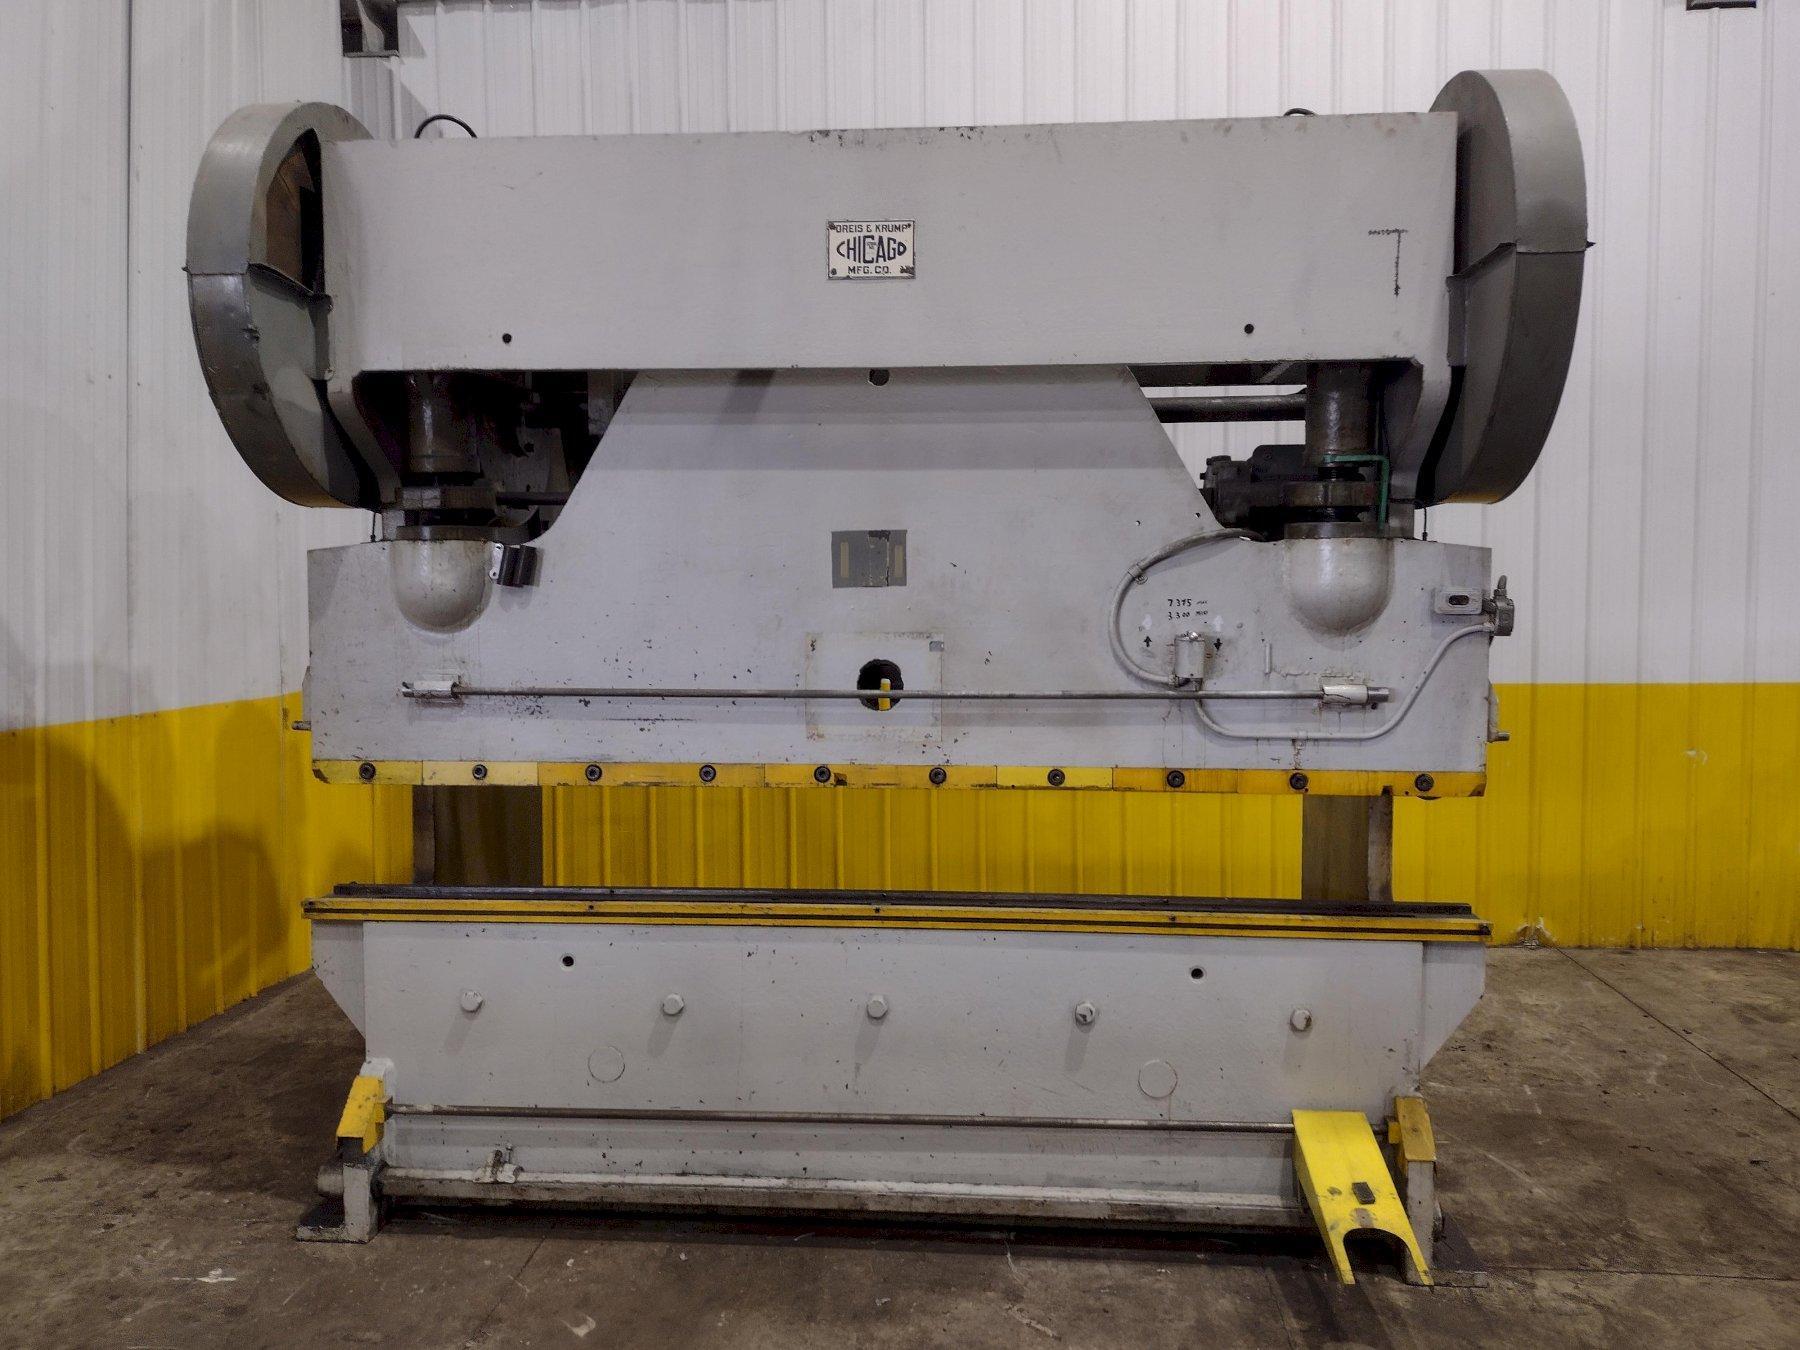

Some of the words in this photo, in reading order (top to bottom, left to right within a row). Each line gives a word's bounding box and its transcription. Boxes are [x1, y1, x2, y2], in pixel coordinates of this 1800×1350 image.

[836, 224, 863, 233] DREIS
[866, 224, 872, 233] &
[875, 224, 908, 233] KRUMP
[836, 235, 907, 264] CHICAGO
[848, 265, 873, 275] MFG.
[875, 265, 892, 275] CO.
